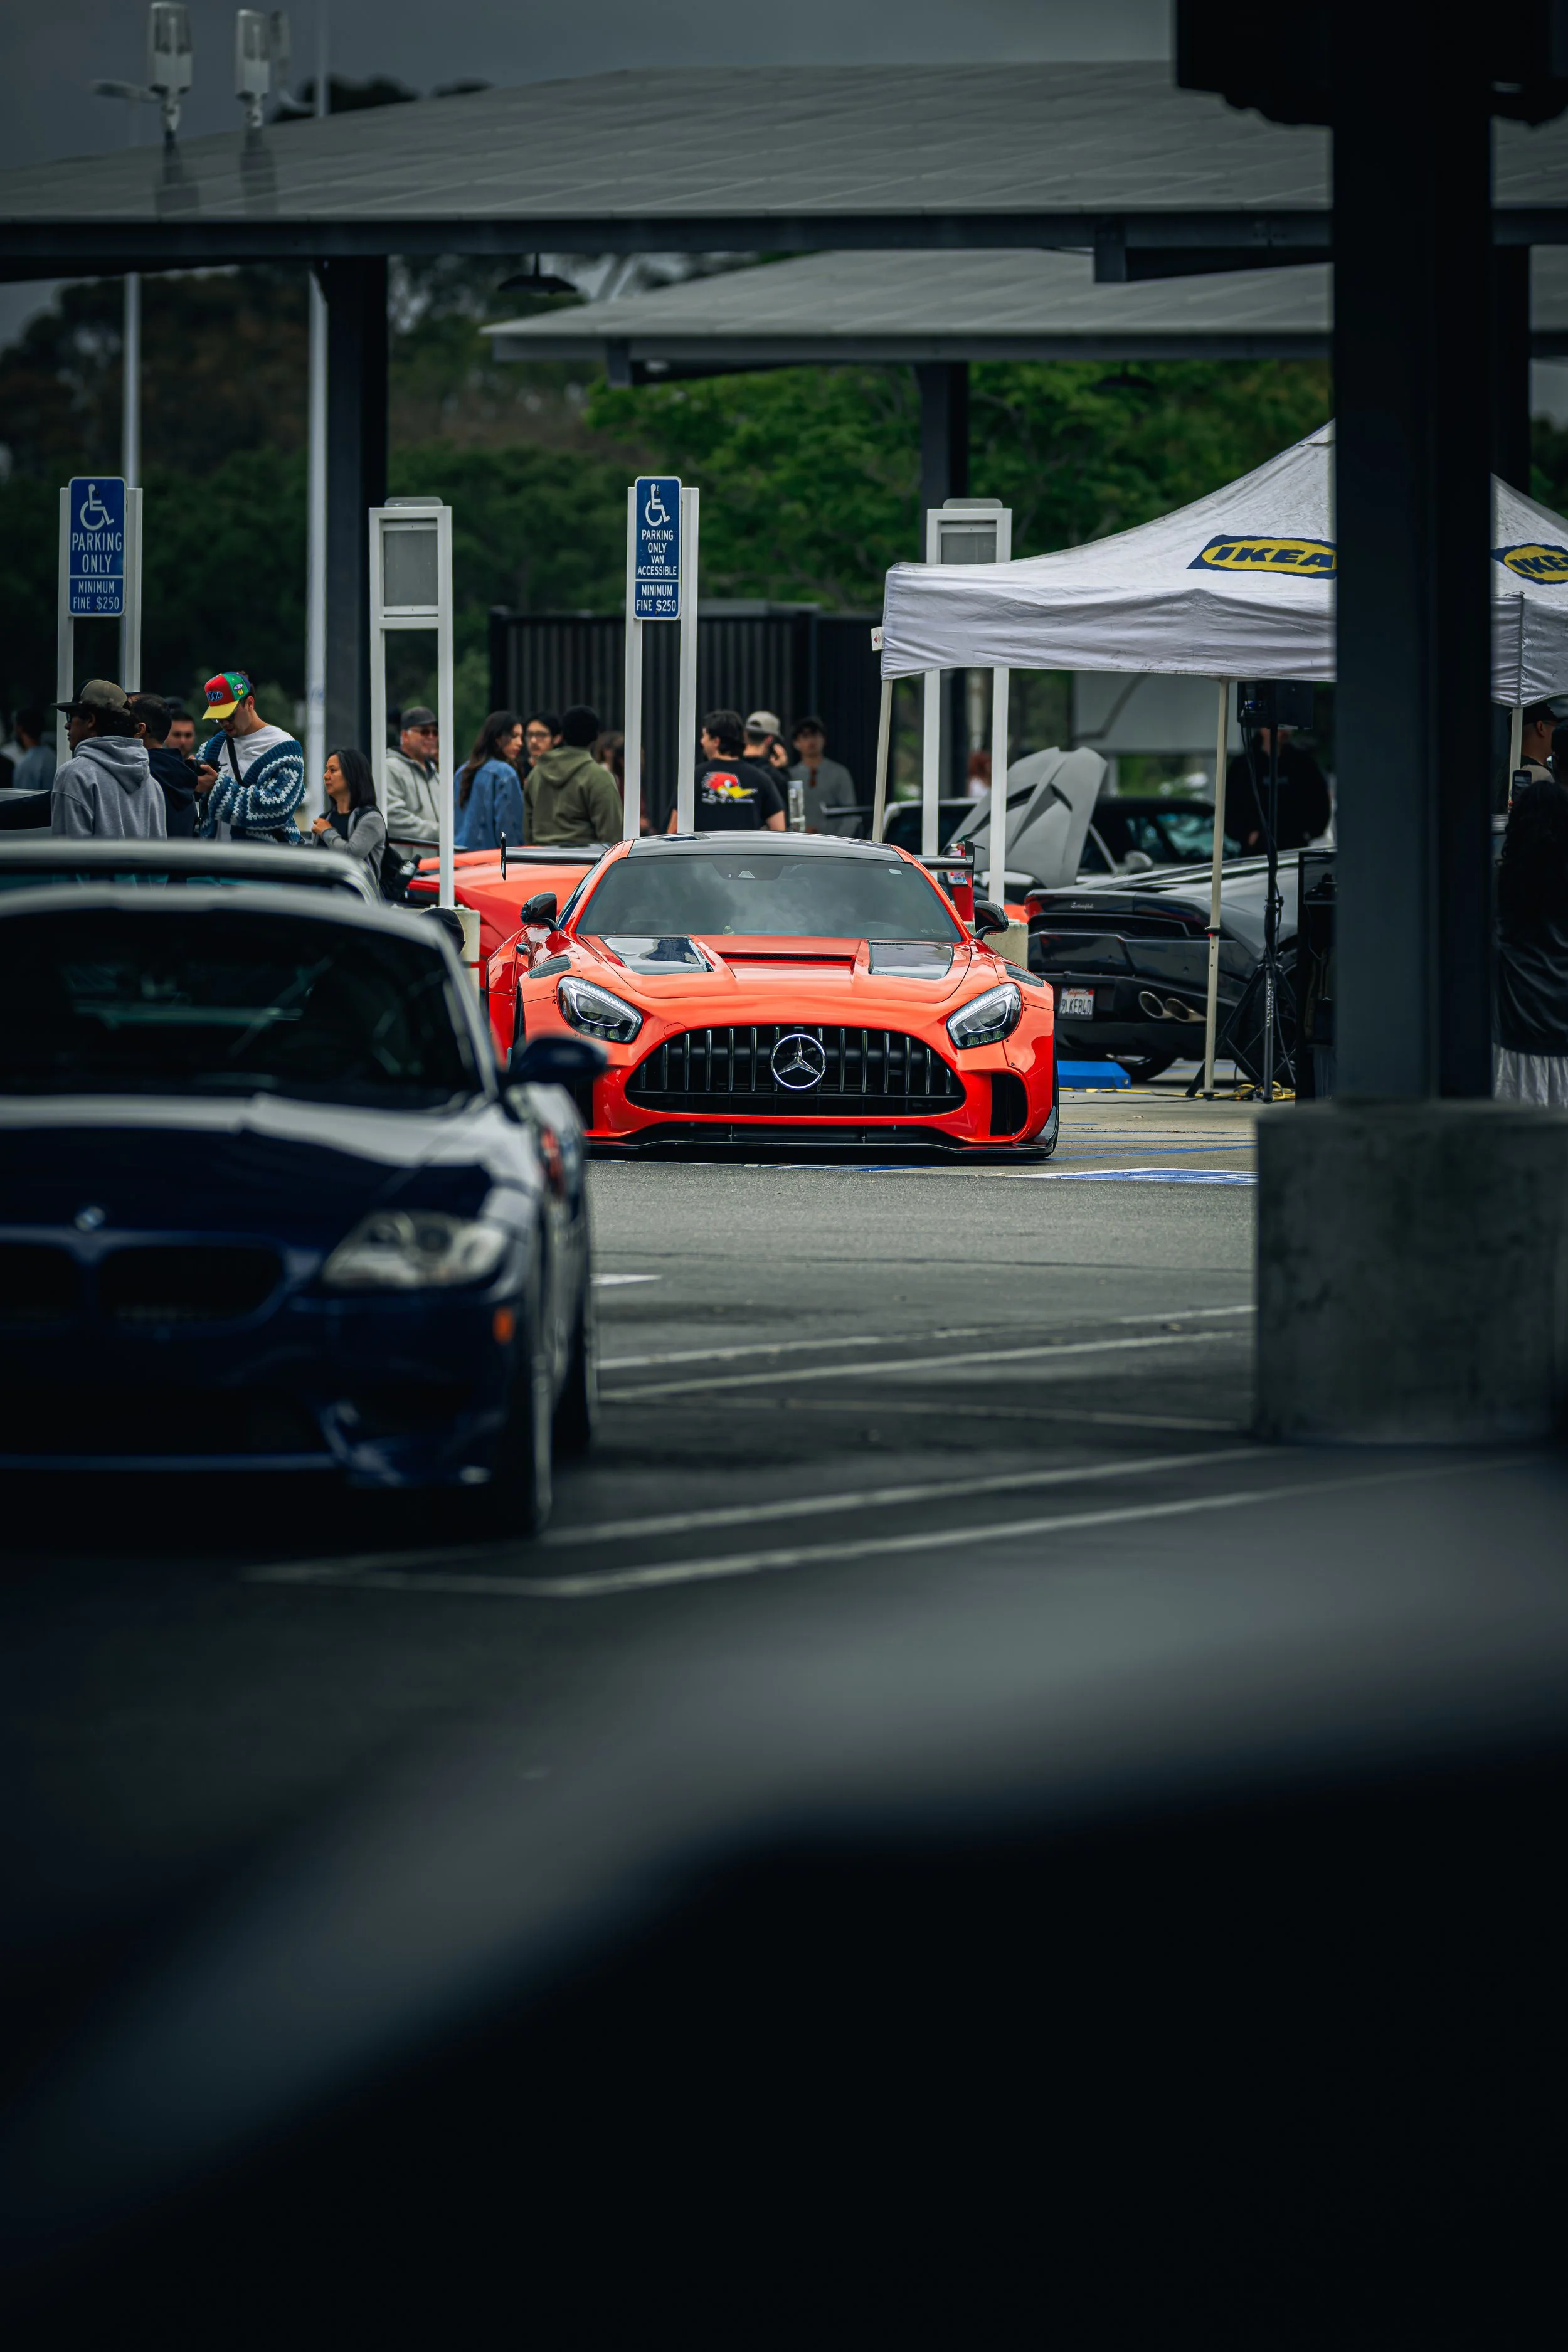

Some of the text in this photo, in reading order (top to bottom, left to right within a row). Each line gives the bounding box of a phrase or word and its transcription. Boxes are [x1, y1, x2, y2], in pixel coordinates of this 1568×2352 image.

[641, 529, 674, 541] PARKING
[72, 532, 122, 551] PARKING
[648, 543, 667, 553] ONLY
[651, 555, 664, 564] VAN
[1212, 546, 1334, 568] IKEA
[82, 554, 112, 573] ONLY
[637, 566, 677, 576] ACCESSIBLE
[78, 581, 114, 593] MINIMUM
[641, 585, 672, 596] MINIMUM
[73, 596, 120, 611] FINE $250
[637, 599, 677, 612] FINE $250
